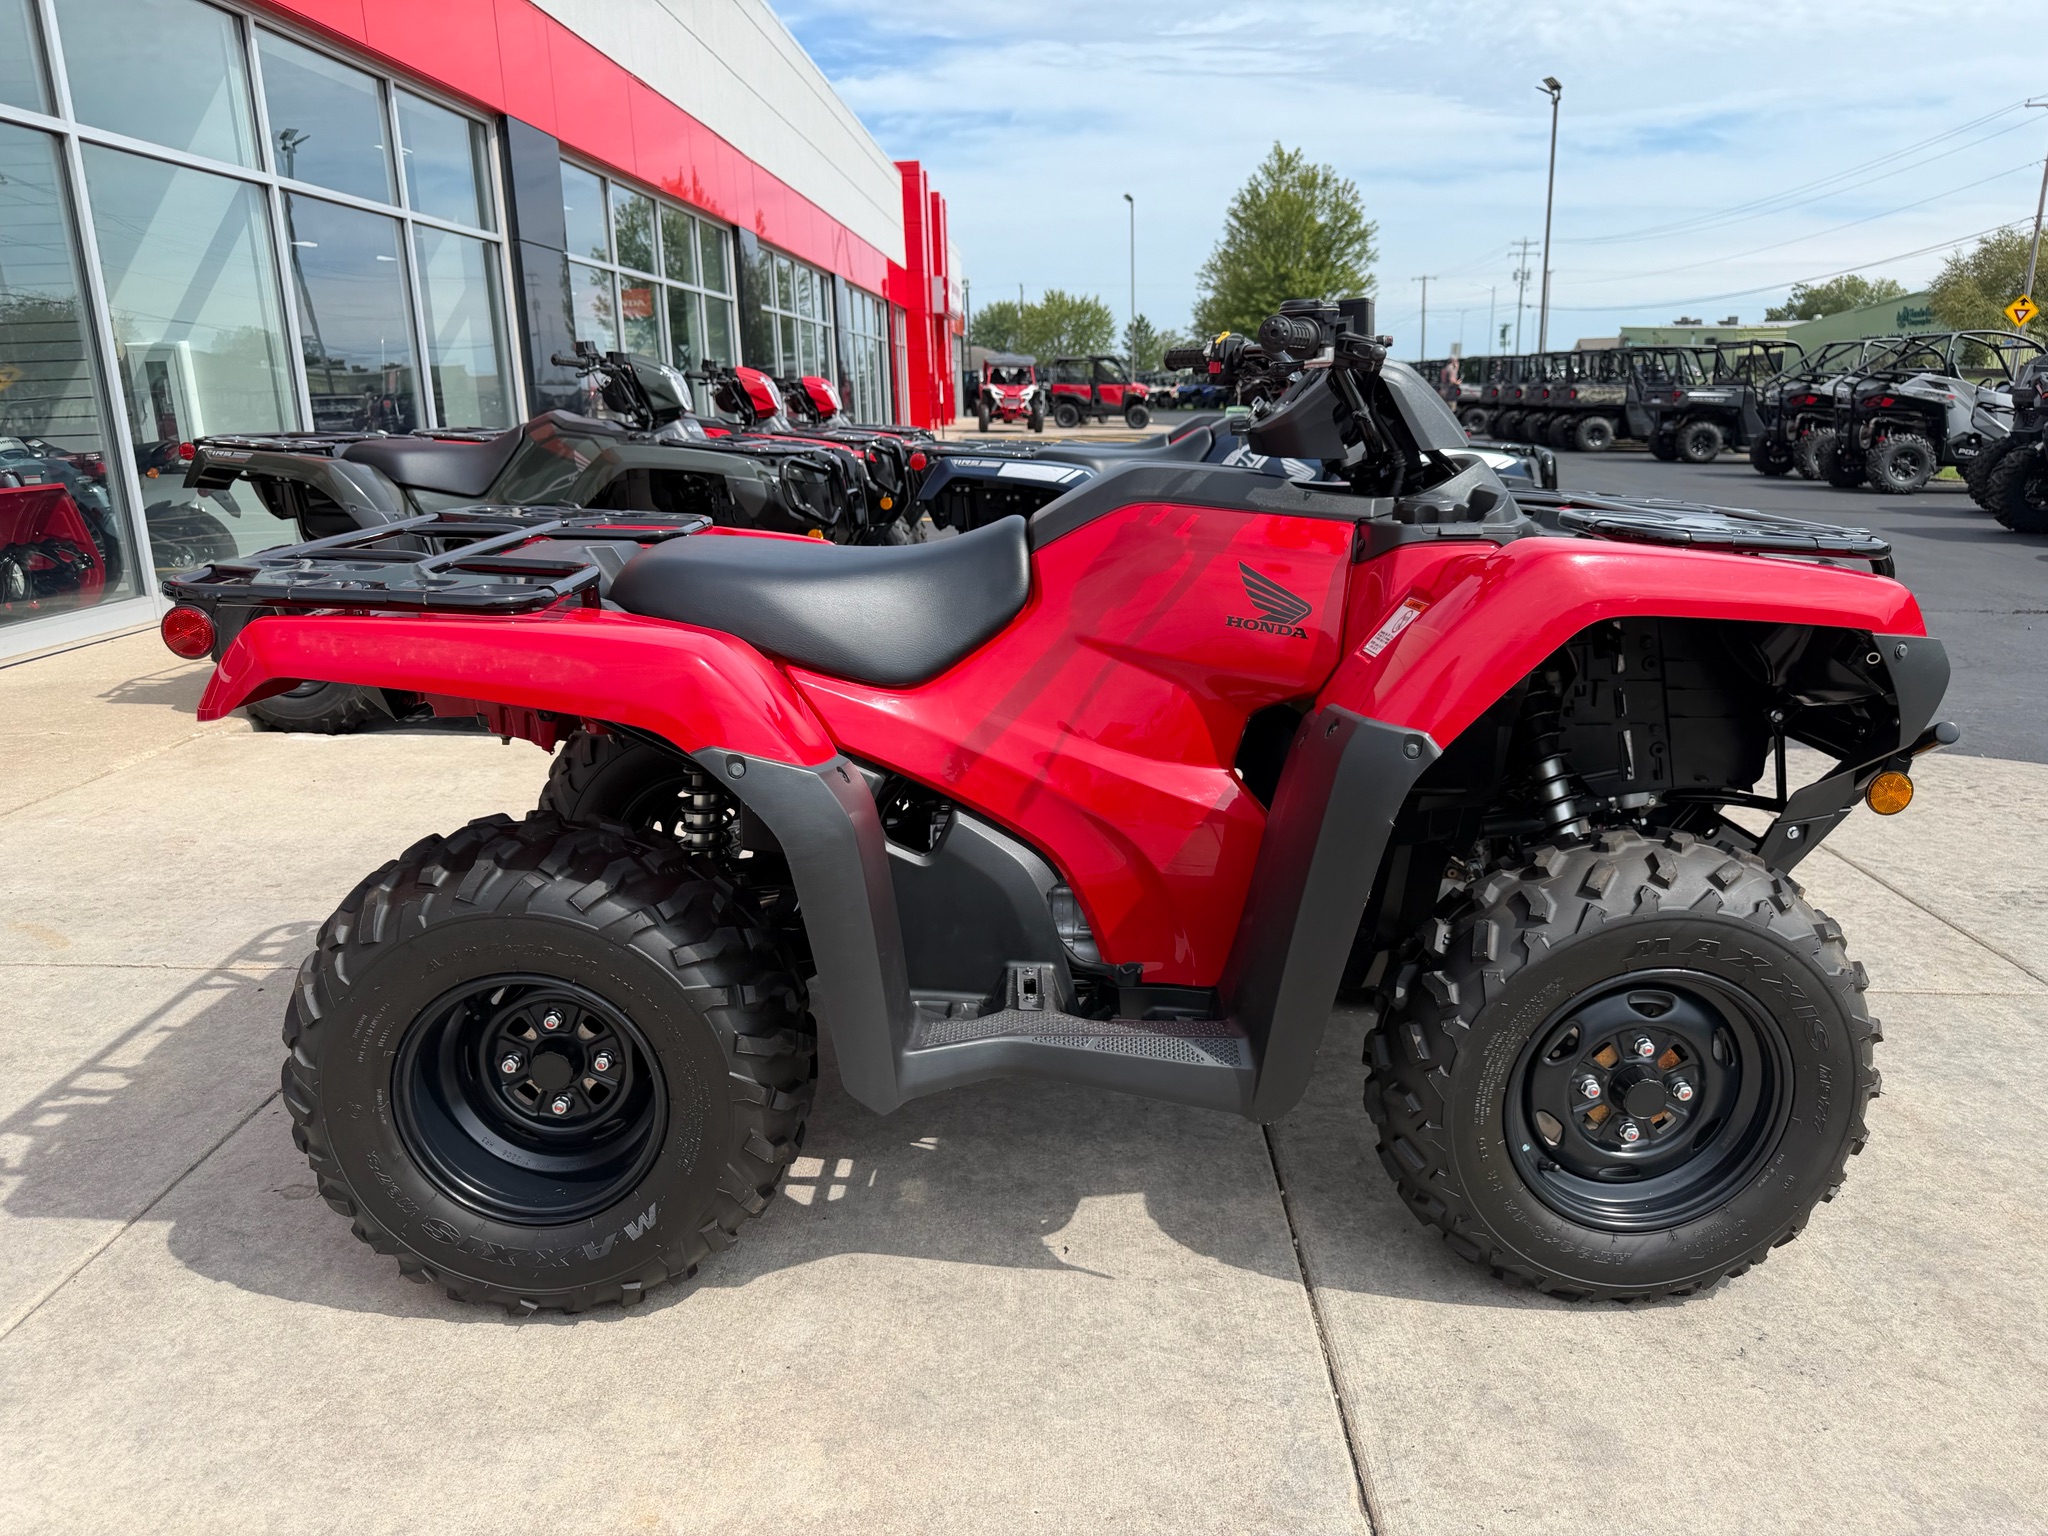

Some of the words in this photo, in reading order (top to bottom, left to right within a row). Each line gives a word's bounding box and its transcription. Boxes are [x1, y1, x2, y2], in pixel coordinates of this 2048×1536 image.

[1225, 615, 1309, 640] HONDA
[1622, 937, 1830, 1051] MAXXIS
[1813, 1063, 1833, 1135] M977
[421, 1201, 658, 1268] MAXXIS
